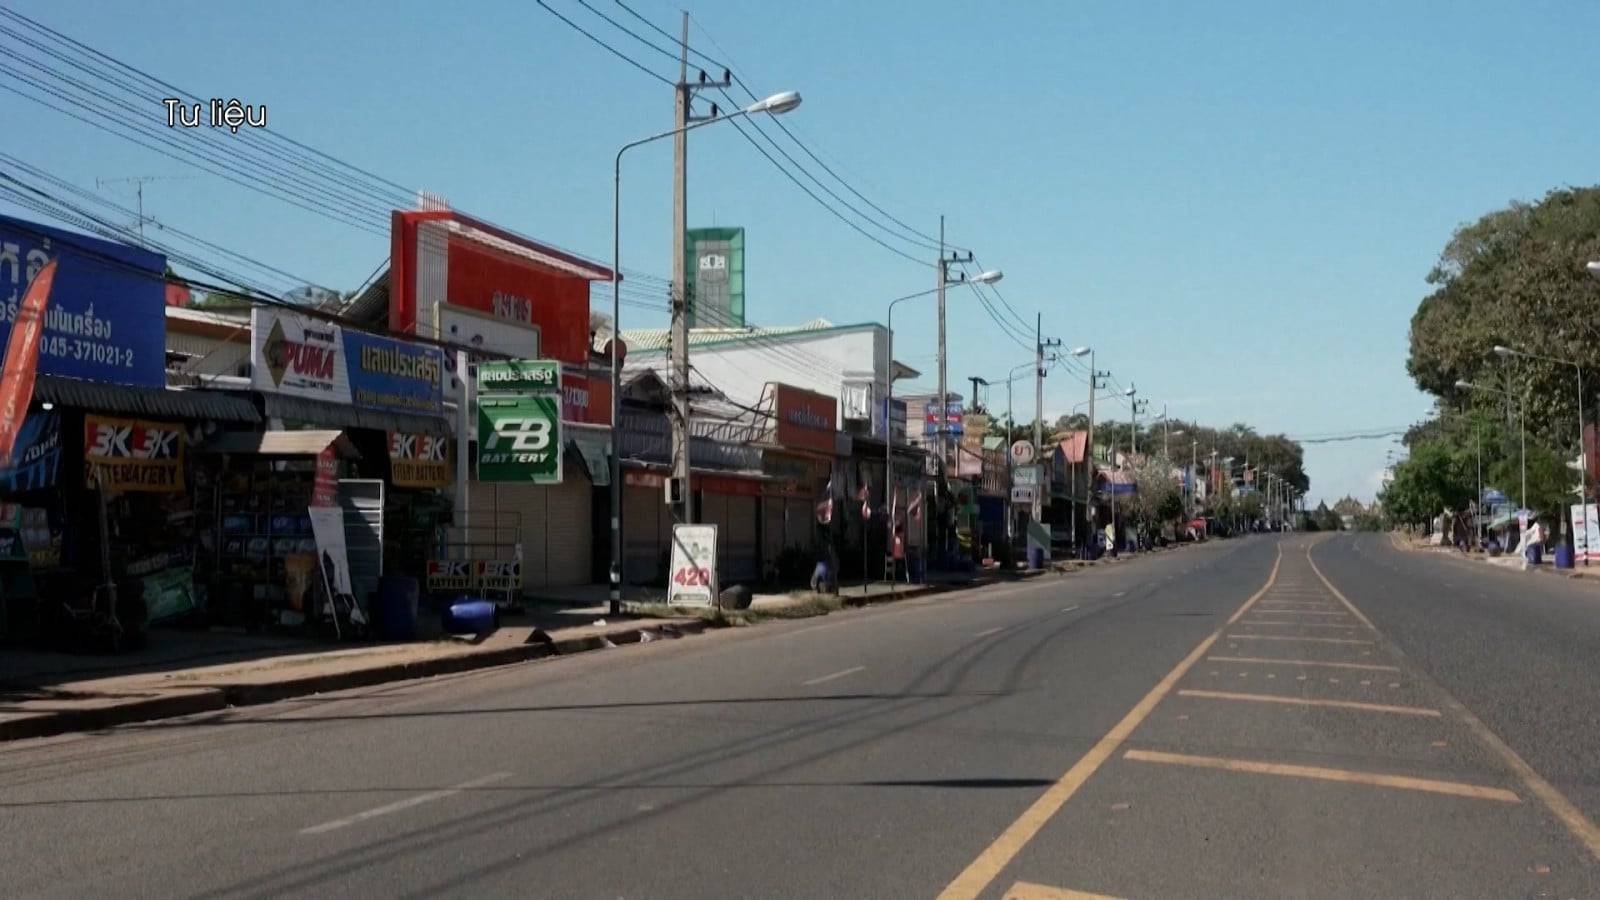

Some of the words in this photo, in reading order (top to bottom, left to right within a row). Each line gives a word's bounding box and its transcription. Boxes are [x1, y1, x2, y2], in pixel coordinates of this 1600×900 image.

[40, 335, 133, 368] 045-371021-2
[282, 341, 334, 380] PUMA
[88, 424, 133, 457] 3K
[133, 428, 178, 460] 3K
[481, 453, 549, 464] BATTERY
[674, 567, 710, 586] 420
